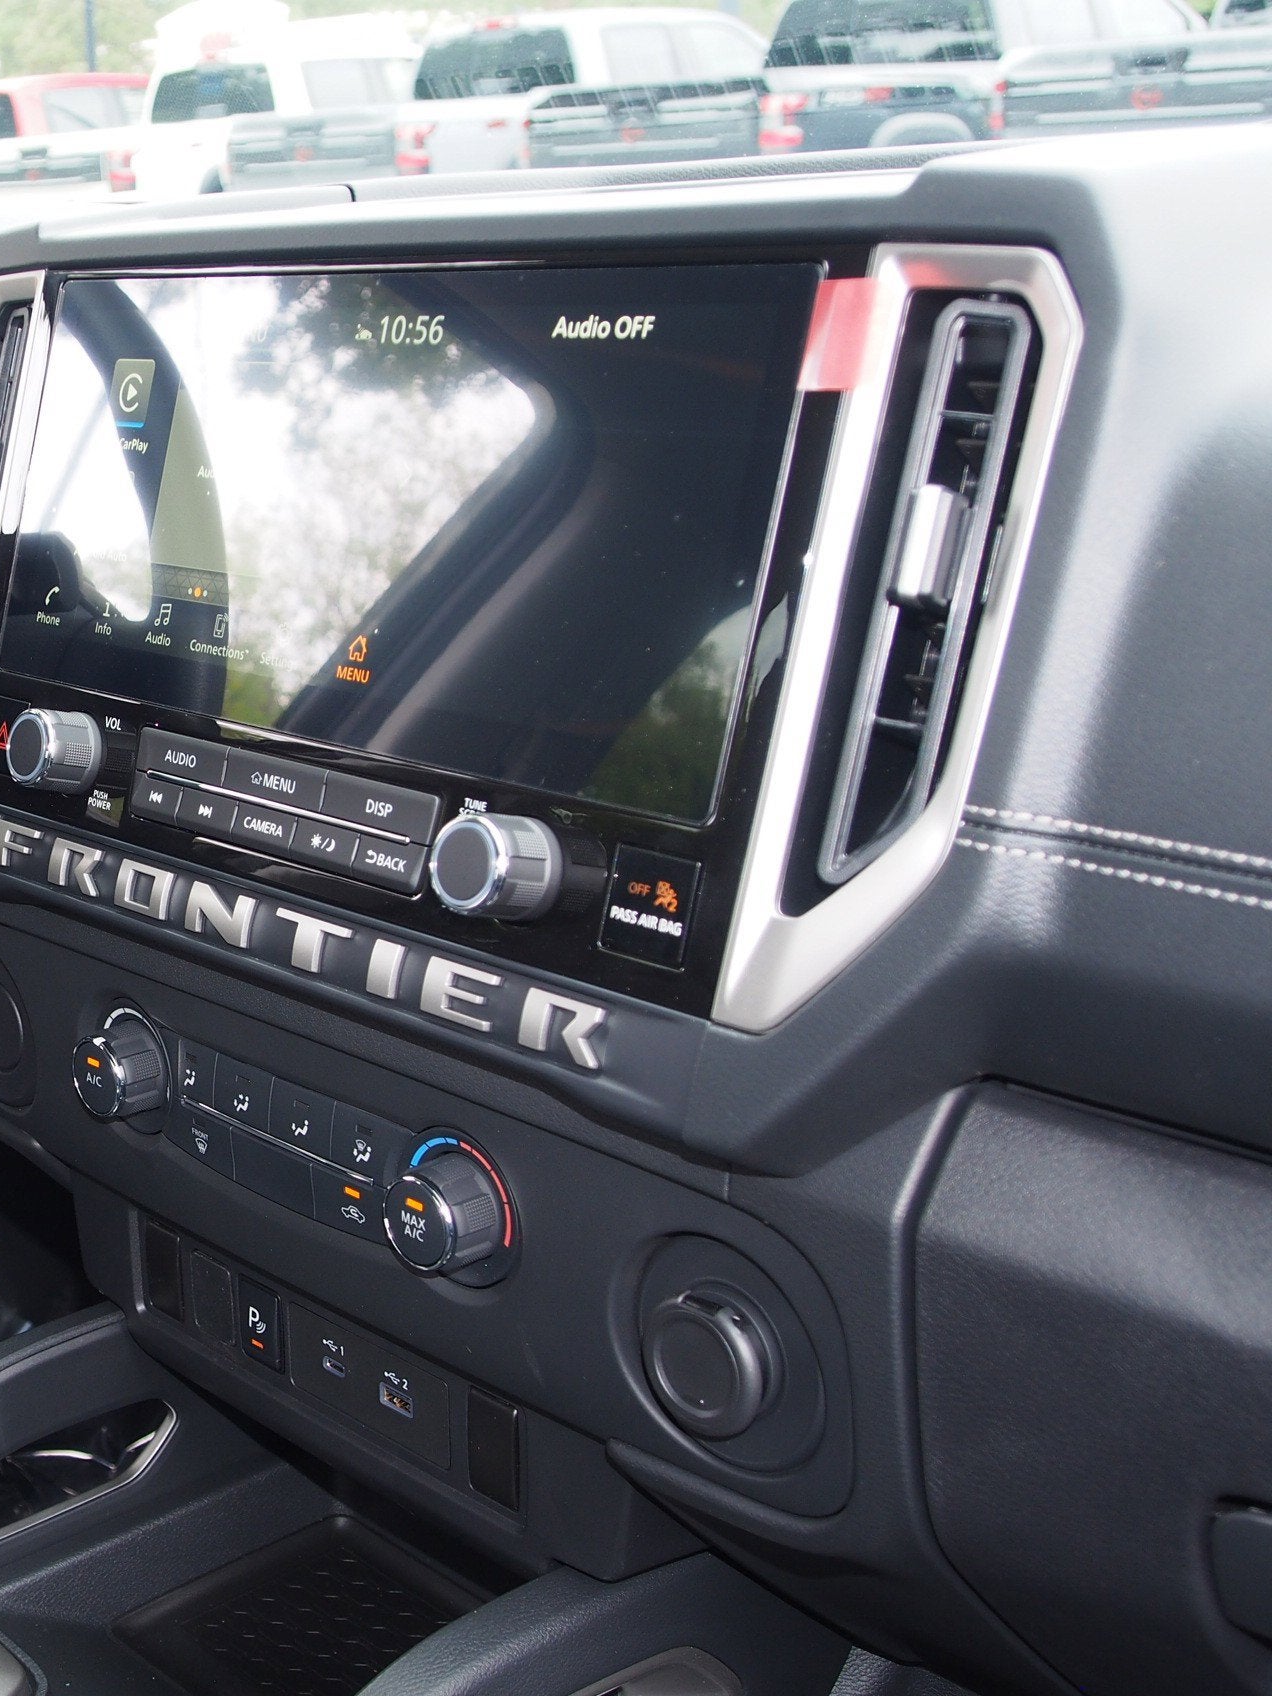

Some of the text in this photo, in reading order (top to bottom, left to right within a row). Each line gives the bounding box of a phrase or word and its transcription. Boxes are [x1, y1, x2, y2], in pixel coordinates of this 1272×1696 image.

[380, 315, 445, 345] 10:56
[551, 314, 656, 340] Audio OFF
[119, 436, 149, 454] CarPlay
[36, 611, 61, 627] Phone
[94, 622, 112, 636] Info
[145, 631, 171, 647] Audio
[259, 652, 294, 672] Setting
[336, 665, 371, 684] MENU
[105, 715, 122, 731] VOL
[164, 749, 197, 768] AUDIO
[263, 773, 296, 794] MENU
[88, 796, 112, 811] POWER
[93, 789, 109, 800] PUSH
[365, 798, 394, 818] DISP
[464, 797, 488, 812] TUNE
[243, 816, 284, 838] CAMERA
[376, 852, 407, 873] BACK
[629, 881, 652, 897] OFF
[609, 905, 683, 937] PASS AIR BAG
[86, 1072, 103, 1088] A/C
[191, 1127, 209, 1141] FRONT
[401, 1209, 426, 1231] MAX
[404, 1224, 424, 1243] A/C
[248, 1306, 261, 1328] P
[400, 1378, 410, 1391] 2
